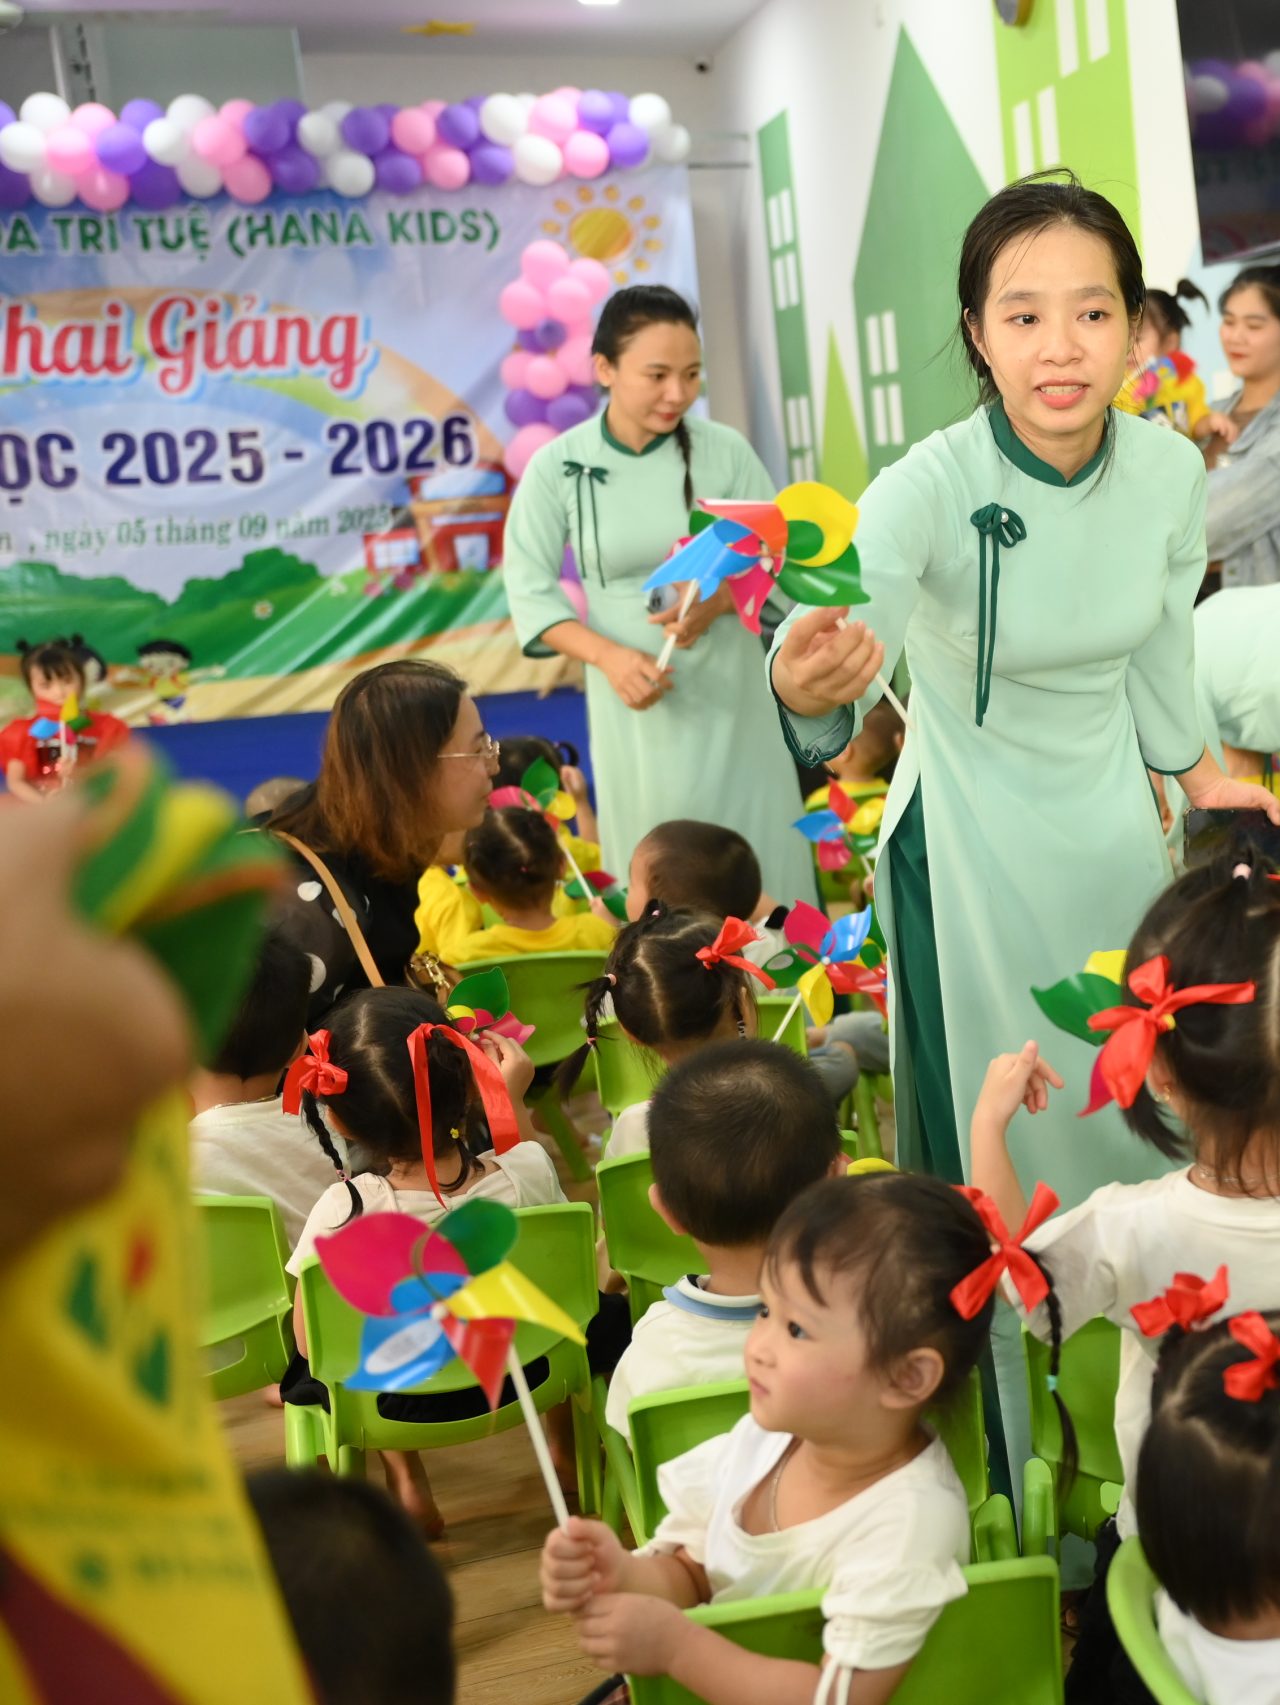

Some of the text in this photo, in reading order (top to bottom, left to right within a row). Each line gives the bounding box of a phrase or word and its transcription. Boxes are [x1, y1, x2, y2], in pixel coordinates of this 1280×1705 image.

[0, 216, 37, 252] A
[133, 206, 210, 261] TUỆ
[227, 211, 372, 259] (HANA
[387, 208, 500, 254] KIDS)
[0, 294, 368, 394] hai Giảng
[102, 429, 265, 486] 2025
[327, 416, 474, 476] 2026
[116, 516, 147, 546] 05
[155, 513, 233, 546] tháng
[239, 512, 267, 539] 09
